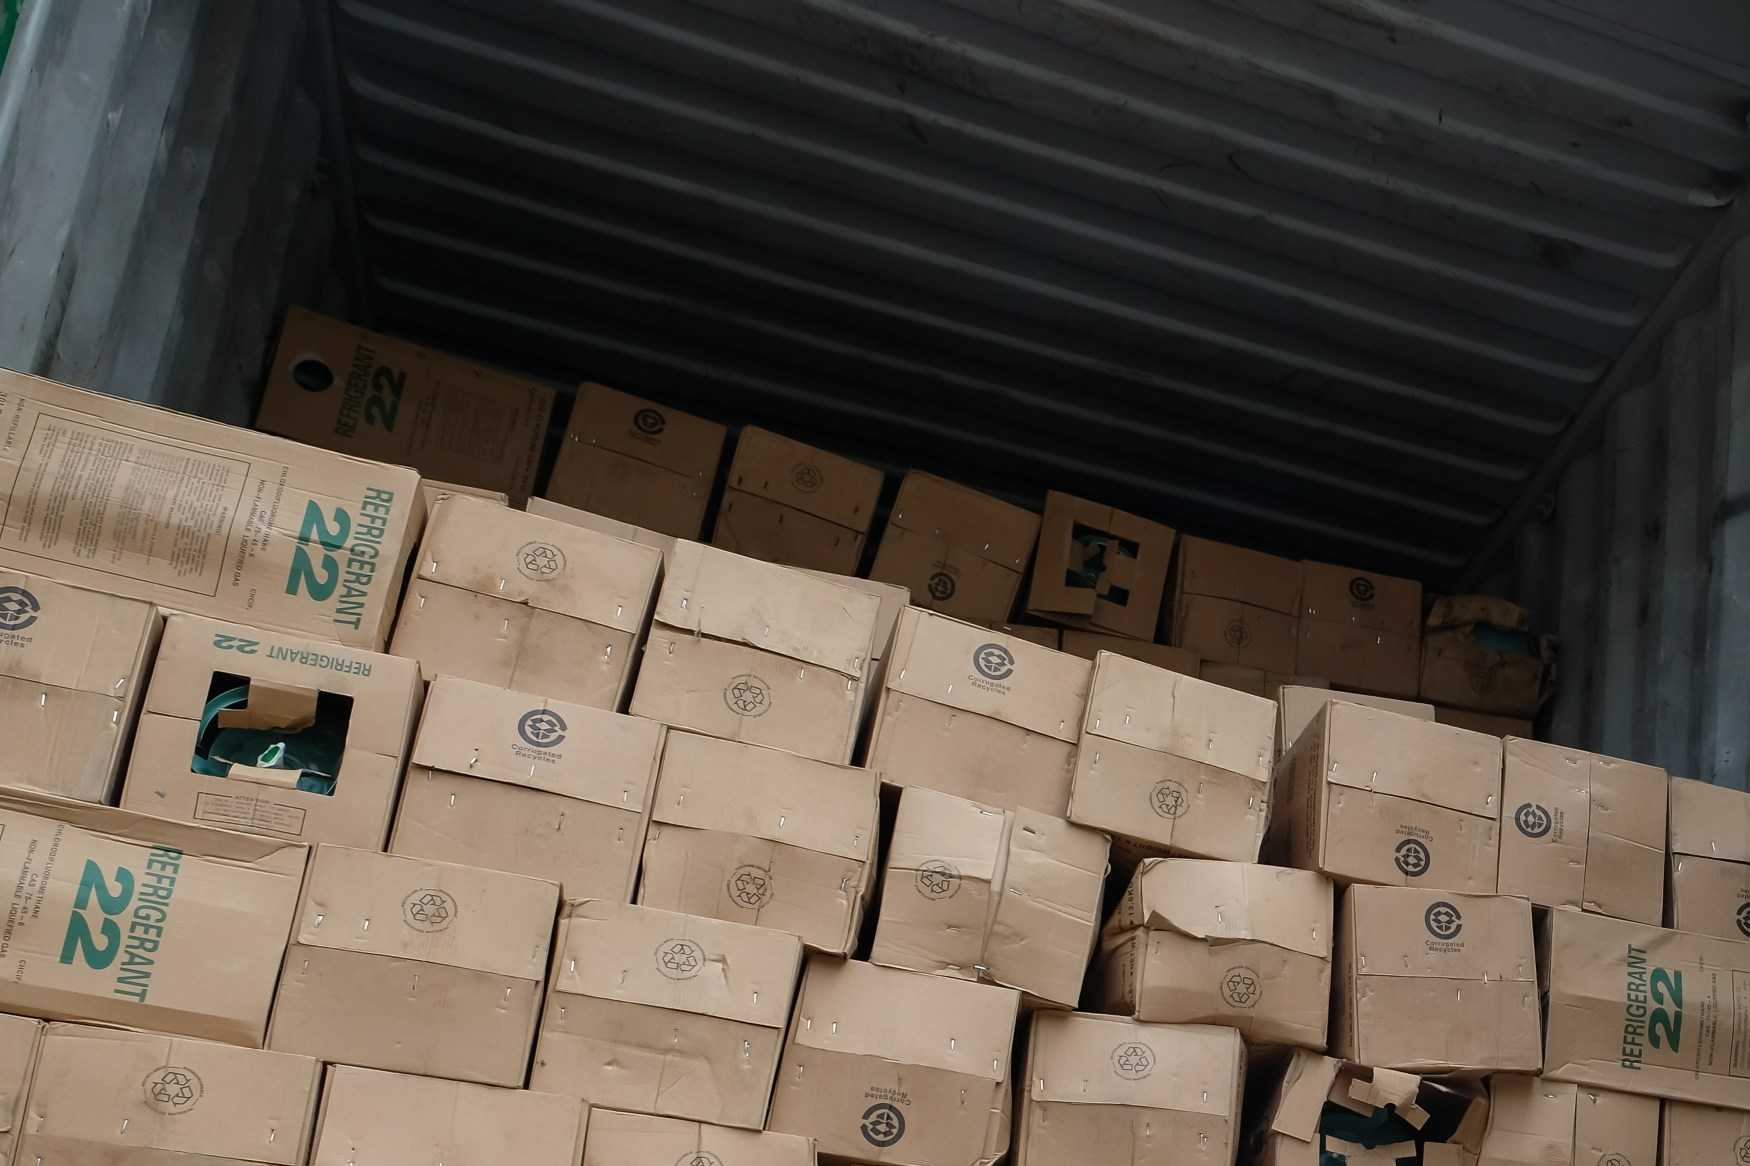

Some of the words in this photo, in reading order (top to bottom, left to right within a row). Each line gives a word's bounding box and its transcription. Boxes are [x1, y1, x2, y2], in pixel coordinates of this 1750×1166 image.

[335, 345, 376, 438] REFRIGERANT
[364, 366, 407, 432] 22
[286, 500, 351, 602] 22
[333, 487, 395, 630] REFRIGERANT
[212, 633, 261, 655] 22
[266, 645, 373, 677] REFRIGERANT
[59, 858, 135, 970] 22
[113, 844, 183, 1004] REFRIGERANT
[1620, 943, 1648, 1071] REFRIGERANT
[1648, 966, 1683, 1054] 22
